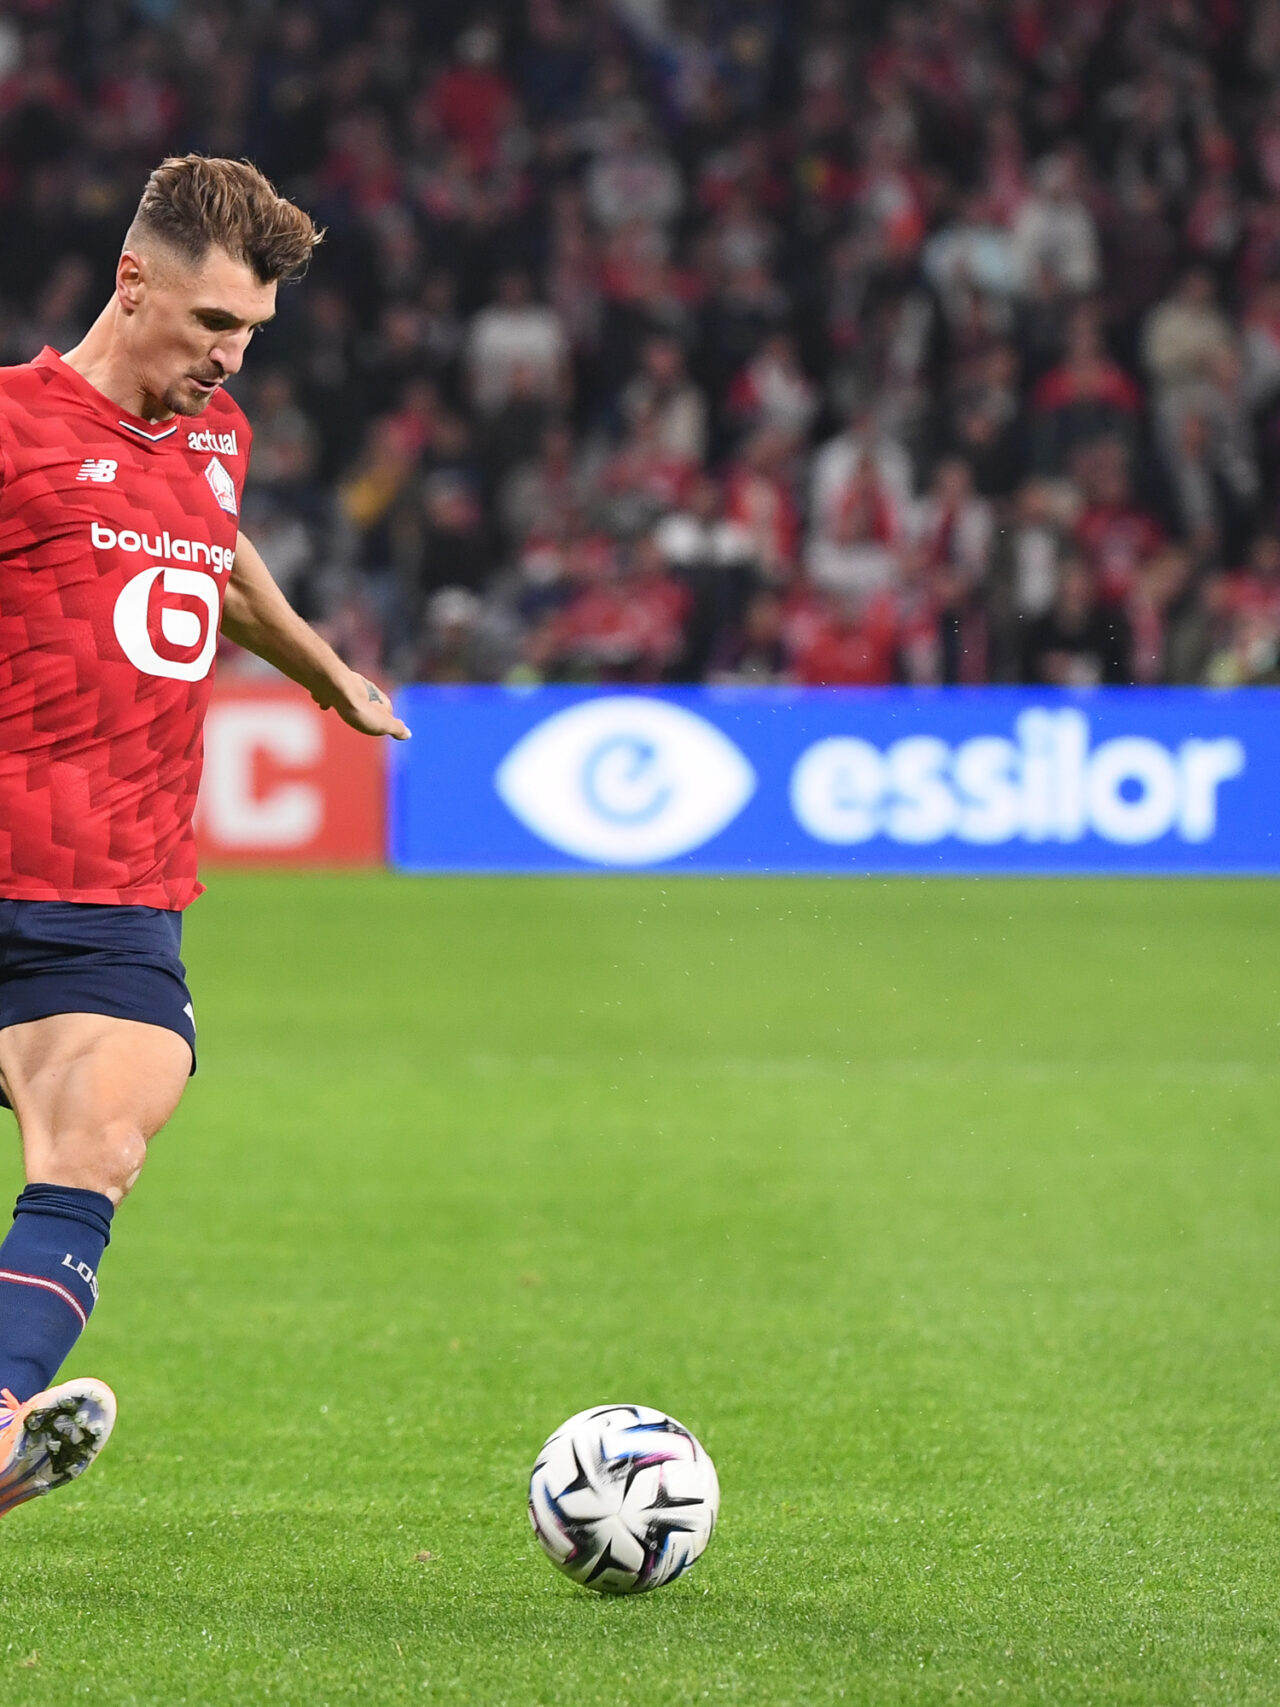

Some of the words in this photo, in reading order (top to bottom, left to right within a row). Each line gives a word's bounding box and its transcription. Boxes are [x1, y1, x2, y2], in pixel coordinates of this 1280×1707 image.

[188, 429, 238, 456] actual
[91, 522, 236, 574] boulange
[791, 707, 1245, 845] essilor
[61, 1253, 100, 1301] LOS
